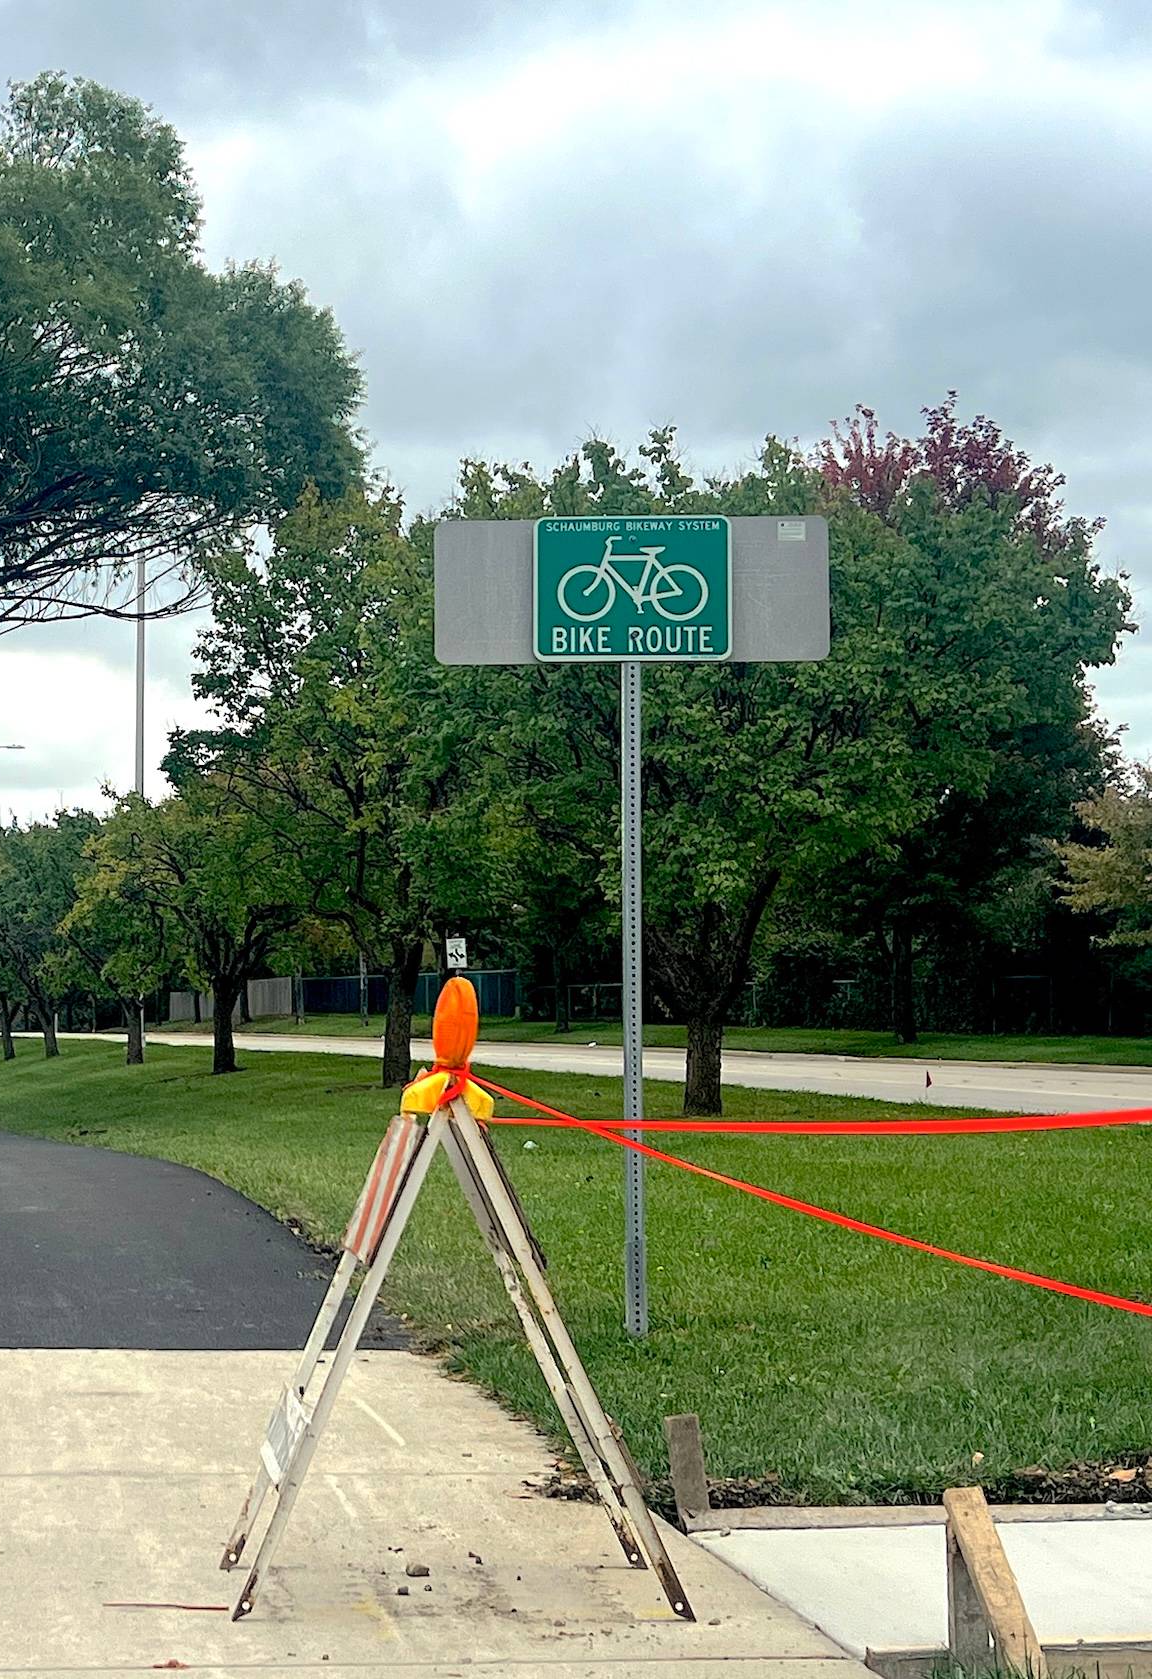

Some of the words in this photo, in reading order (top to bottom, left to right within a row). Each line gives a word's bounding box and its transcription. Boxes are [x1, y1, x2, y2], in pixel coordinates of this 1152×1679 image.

[546, 521, 621, 532] SCHAUMBURG
[626, 521, 673, 531] BIKEWAY
[678, 520, 720, 531] SYSTEM
[552, 626, 612, 653] BIKE
[628, 626, 714, 653] ROUTE
